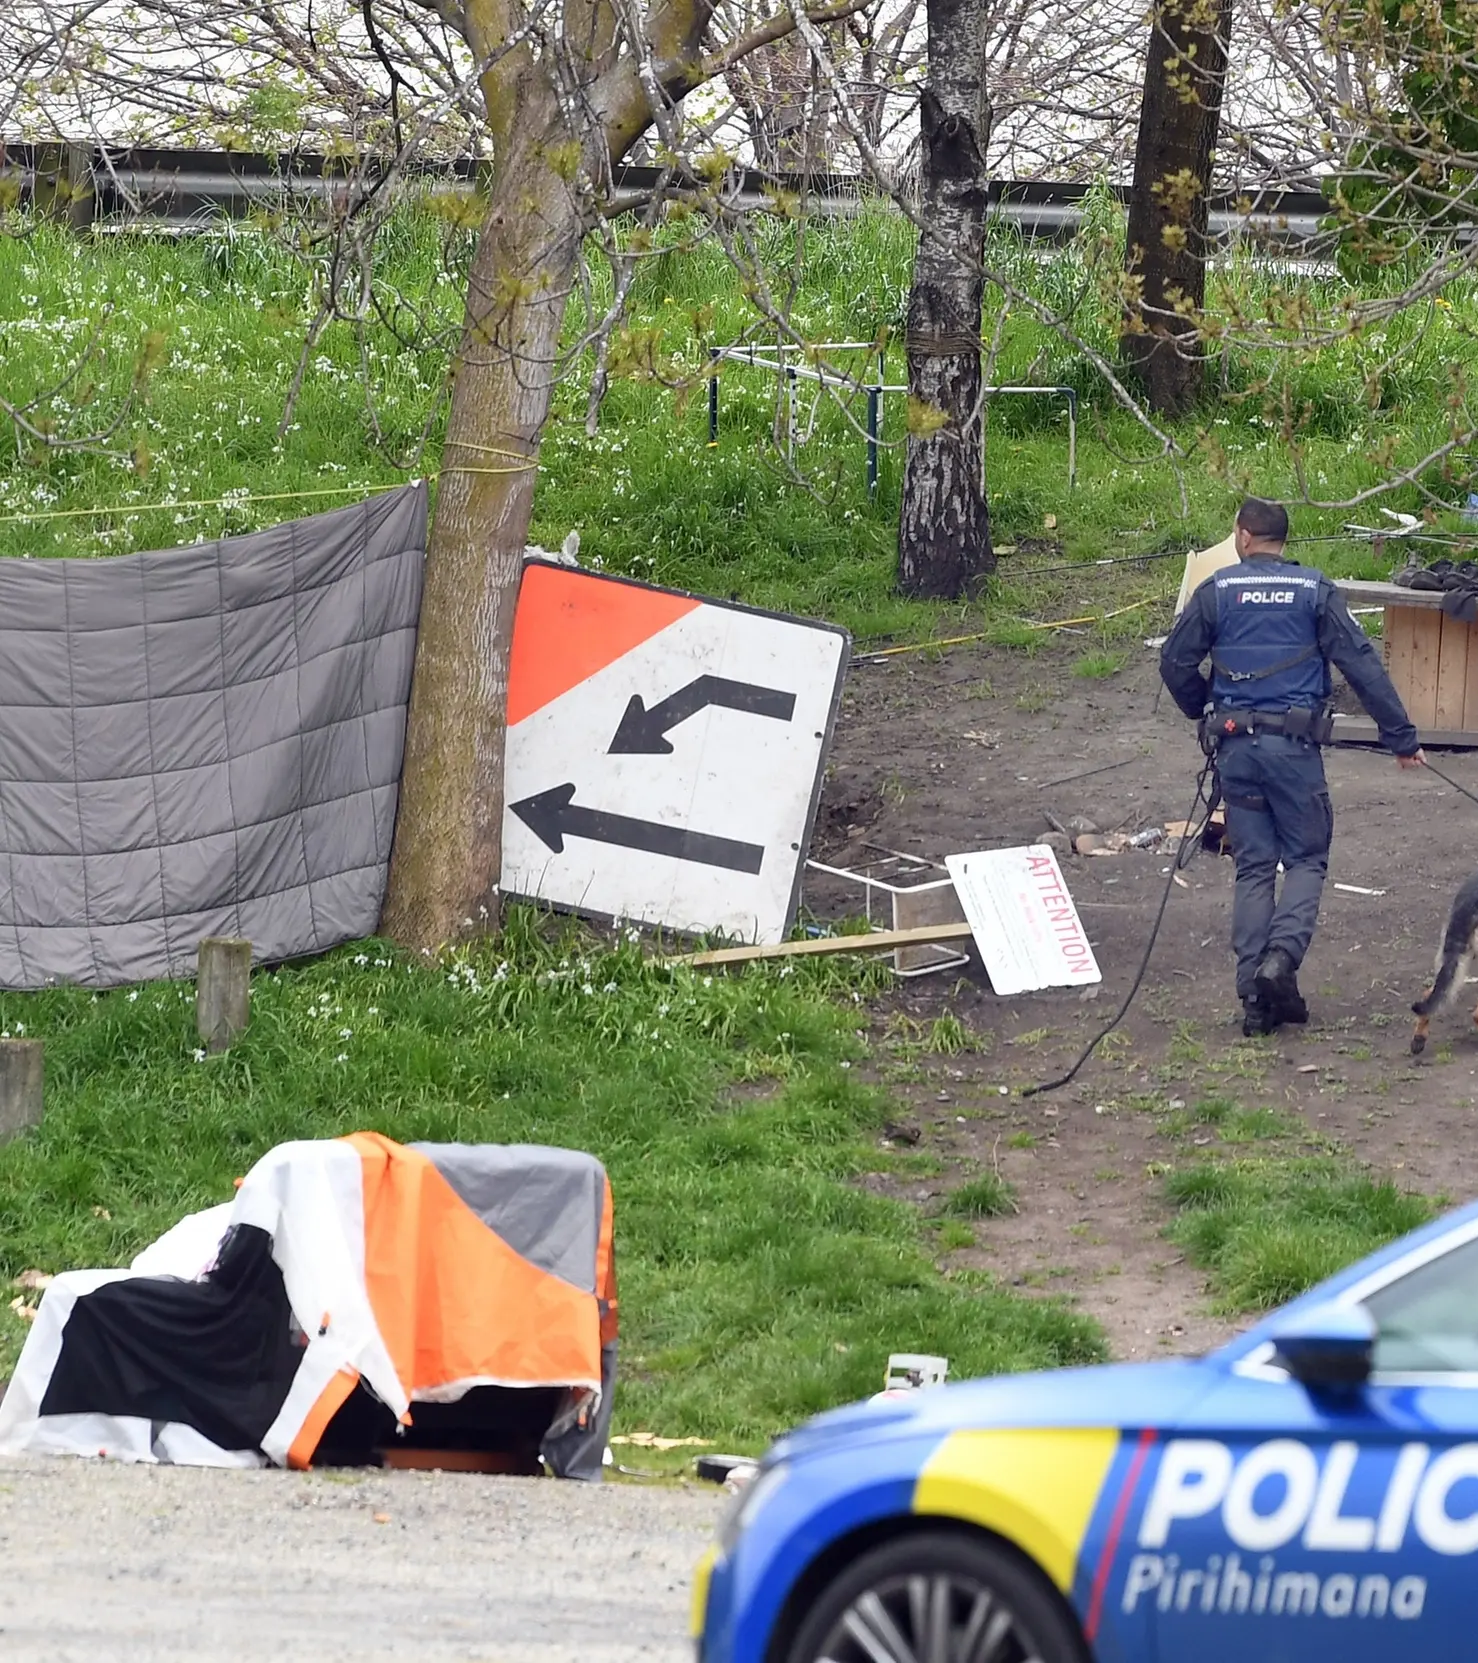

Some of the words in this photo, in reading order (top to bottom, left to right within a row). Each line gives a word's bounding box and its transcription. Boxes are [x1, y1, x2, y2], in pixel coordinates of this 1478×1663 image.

[1241, 591, 1295, 604] POLICE
[1026, 856, 1093, 974] ATTENTION
[1120, 1551, 1428, 1620] Pirihimana
